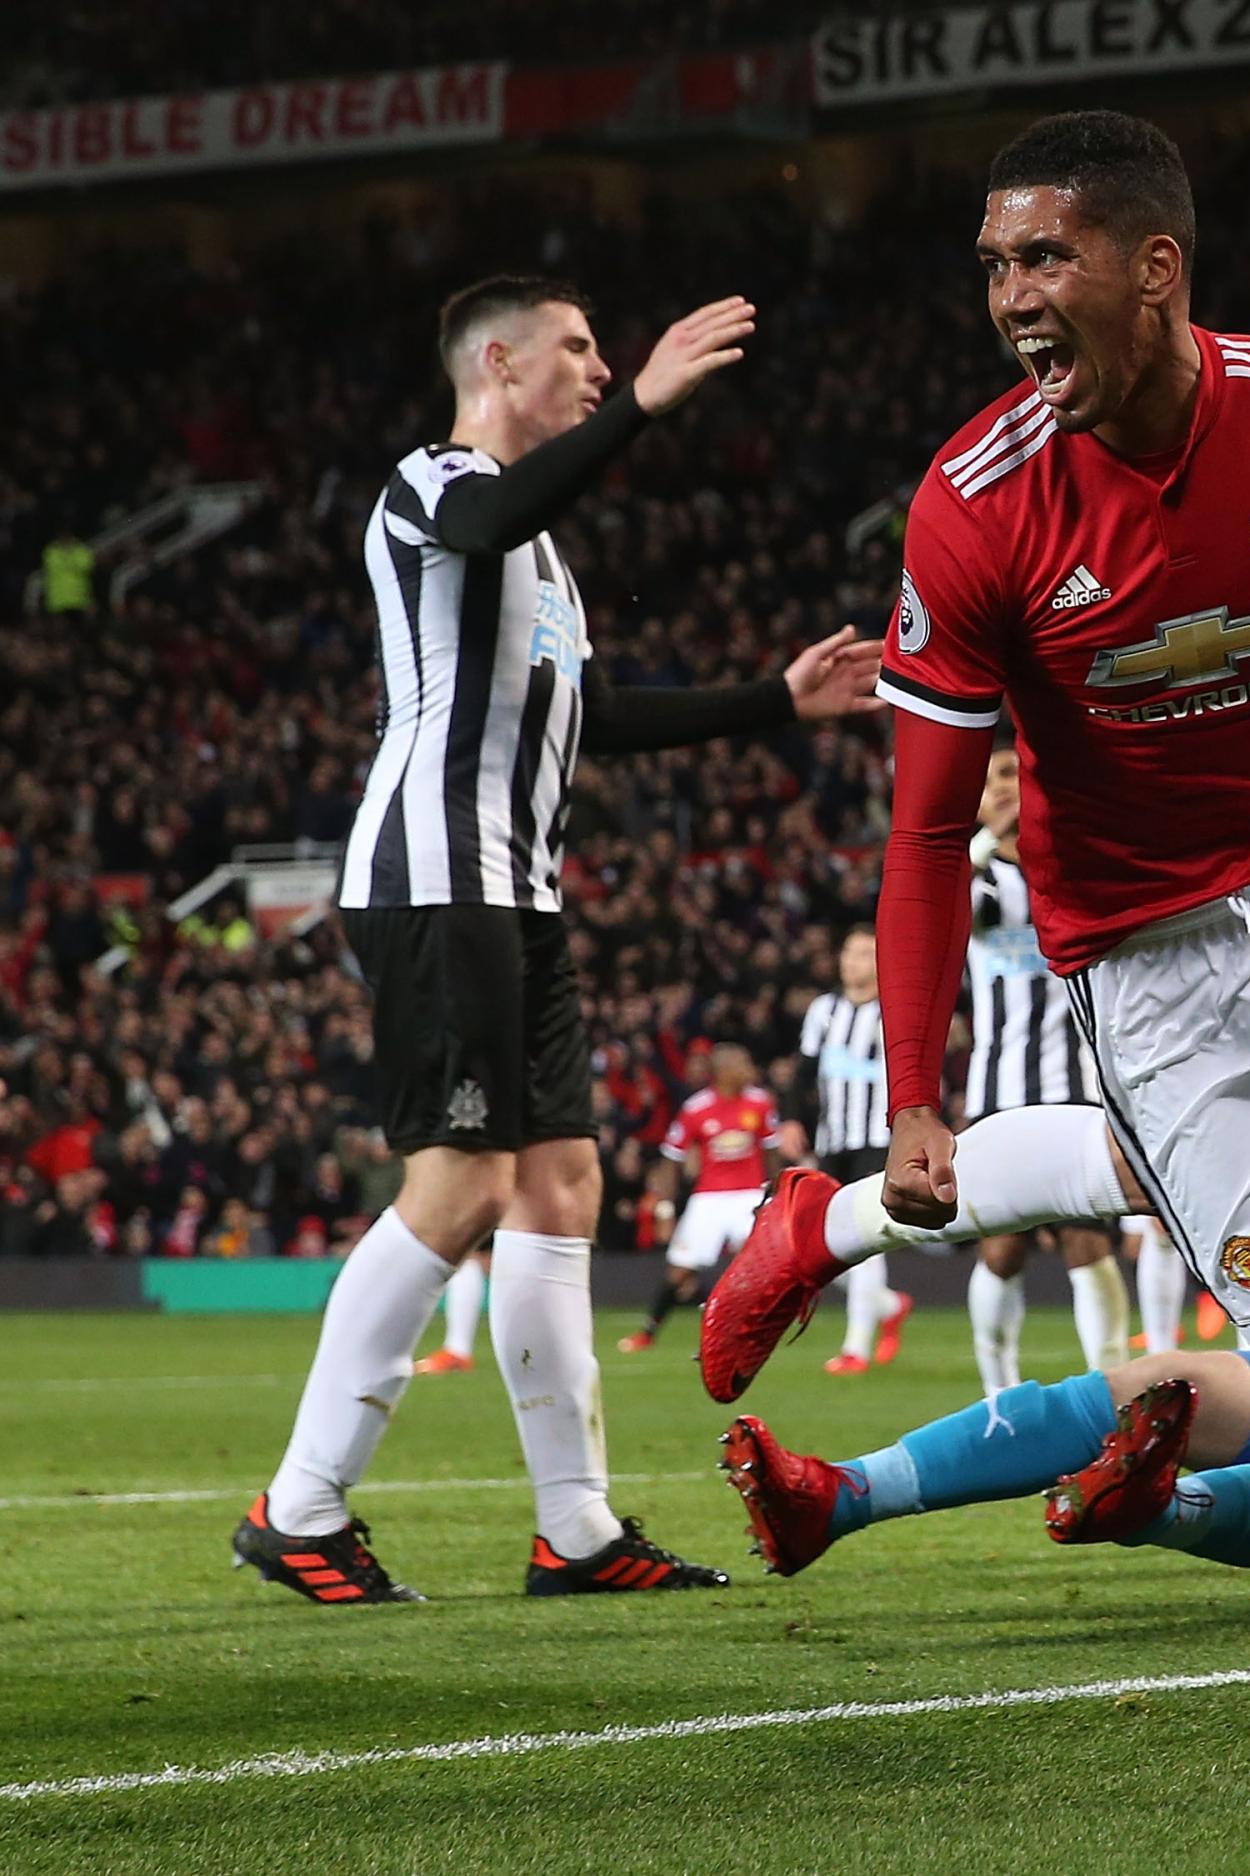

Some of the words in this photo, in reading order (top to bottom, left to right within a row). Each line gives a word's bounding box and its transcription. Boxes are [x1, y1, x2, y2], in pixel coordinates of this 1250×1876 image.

[822, 14, 950, 88] SIR
[972, 0, 1197, 67] ALEX
[3, 94, 203, 172] SIBLE
[232, 64, 490, 148] DREAM
[1052, 586, 1112, 611] adidas
